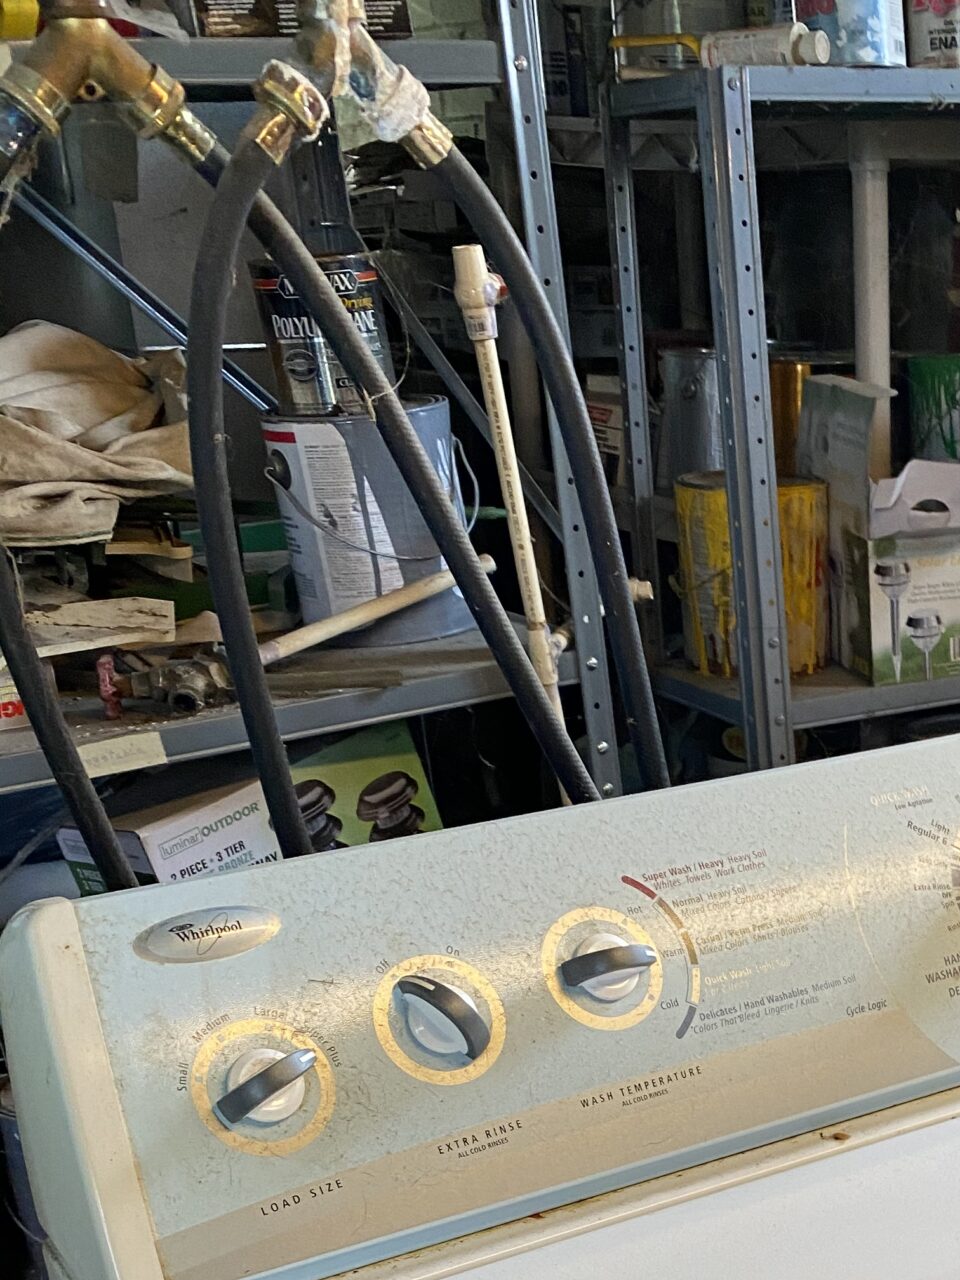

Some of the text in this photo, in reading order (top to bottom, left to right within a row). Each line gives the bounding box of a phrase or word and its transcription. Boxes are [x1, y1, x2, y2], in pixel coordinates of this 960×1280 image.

[202, 802, 260, 837] OUTDOOR
[931, 819, 950, 836] Light
[907, 820, 940, 843] Regular
[161, 831, 201, 857] luminar
[180, 858, 209, 880] PIECE
[216, 850, 224, 862] 3
[224, 840, 246, 857] TIER
[642, 870, 668, 883] Super
[669, 864, 692, 876] Wash
[700, 859, 724, 871] Heavy
[728, 854, 751, 864] Heavy
[752, 848, 767, 859] Soil
[653, 861, 766, 891] Whites Towels Work Clothes
[671, 886, 747, 909] Normal Heavy Soil
[627, 905, 643, 916] Hot
[175, 920, 243, 944] Whirlpool
[696, 931, 723, 945] Casual
[752, 921, 774, 932] Press
[446, 945, 460, 958] On
[661, 947, 685, 959] Warm
[375, 959, 392, 975] Off
[704, 974, 729, 986] Quick
[729, 967, 752, 979] Wash
[660, 998, 680, 1010] Cold
[699, 1007, 738, 1022] Delicates
[744, 997, 766, 1010] Hand
[766, 987, 809, 1004] Washables
[812, 978, 842, 993] Medium
[843, 973, 857, 984] Soil
[846, 999, 888, 1018] Cycle Logic
[253, 1006, 286, 1020] Large
[720, 1016, 738, 1028] That
[739, 1010, 760, 1023] Bleed
[764, 1002, 795, 1016] Lingerie
[800, 994, 820, 1007] Knits
[191, 1012, 232, 1044] Medium
[328, 1046, 343, 1068] Plus
[177, 1062, 189, 1092] Small
[580, 1065, 703, 1109] WASH TEMPERATURE
[621, 1088, 669, 1107] ALL COLD RINSES
[438, 1119, 523, 1155] EXTRA RINSE
[457, 1138, 510, 1159] ALL COLD RINSES
[260, 1179, 343, 1217] LOAD SIZE
